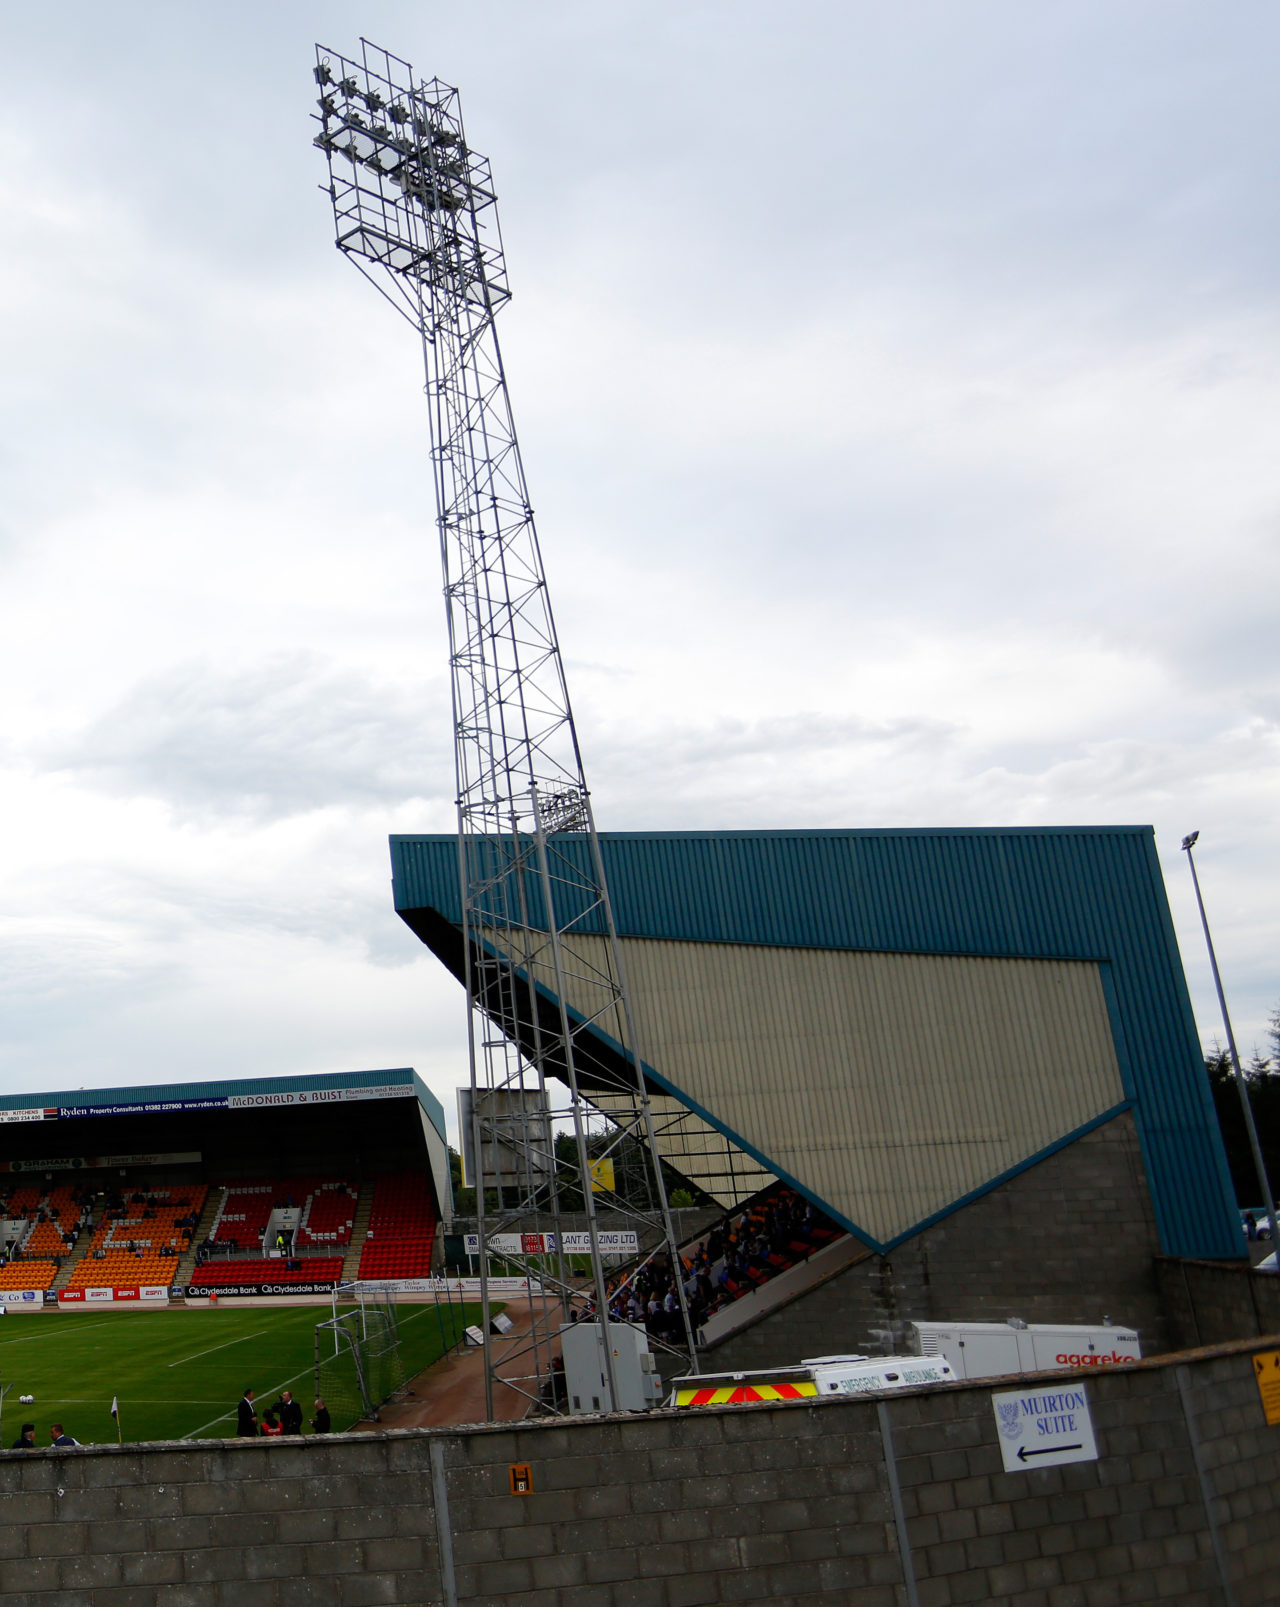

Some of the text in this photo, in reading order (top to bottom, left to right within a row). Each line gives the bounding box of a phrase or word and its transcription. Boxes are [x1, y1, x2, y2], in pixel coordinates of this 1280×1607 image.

[232, 1090, 342, 1107] McDONALD & BUIST
[60, 1108, 87, 1118] Ryden
[89, 1107, 112, 1115] Property
[113, 1105, 144, 1113] Consultants
[620, 1234, 636, 1244] LTD
[200, 1286, 257, 1295] Clydesdale Bank
[273, 1284, 332, 1293] Clydesdale Bank
[1020, 1391, 1085, 1416] MUIRTON
[1037, 1414, 1078, 1436] SUITE
